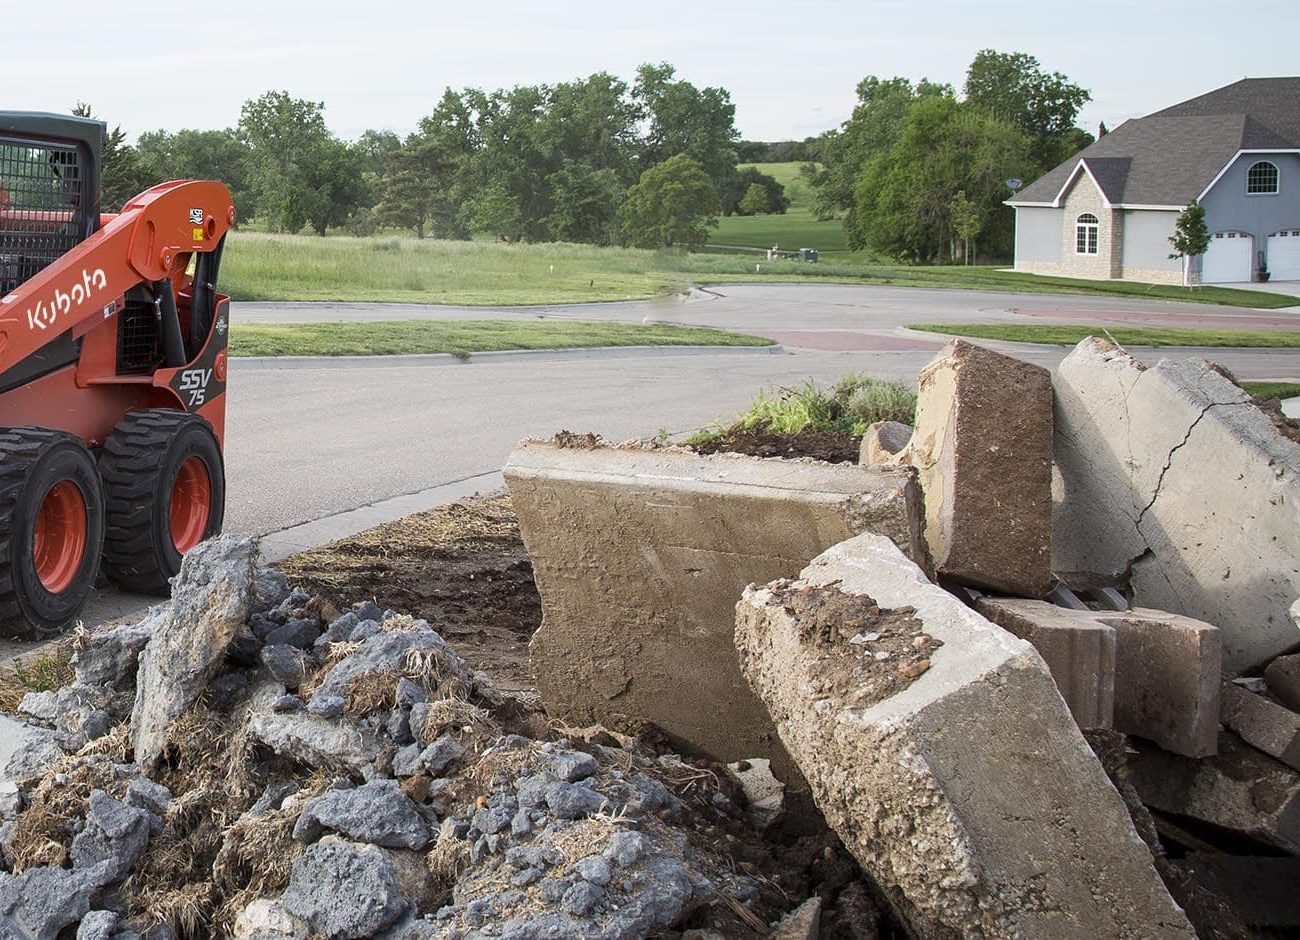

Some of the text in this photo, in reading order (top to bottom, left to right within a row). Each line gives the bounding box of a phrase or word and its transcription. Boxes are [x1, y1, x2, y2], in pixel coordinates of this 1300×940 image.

[27, 268, 107, 330] Kubota
[179, 368, 212, 390] SSV
[188, 389, 206, 406] 75
